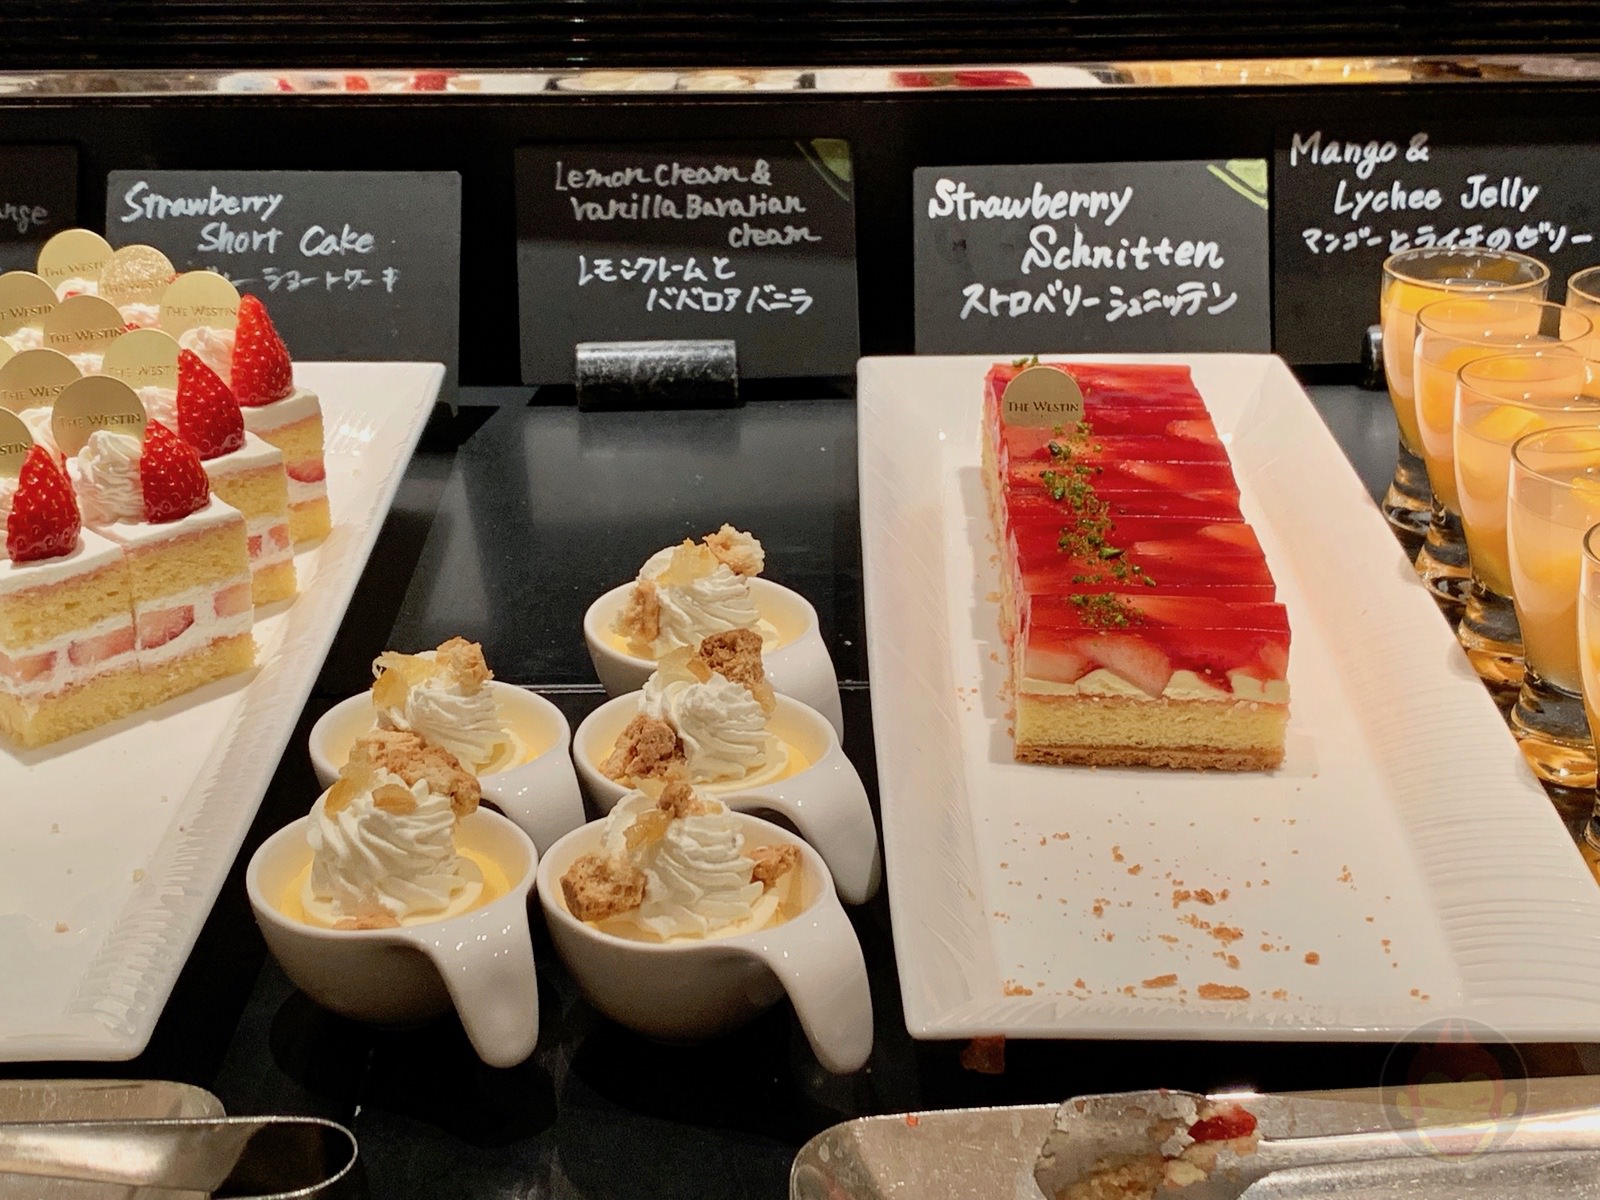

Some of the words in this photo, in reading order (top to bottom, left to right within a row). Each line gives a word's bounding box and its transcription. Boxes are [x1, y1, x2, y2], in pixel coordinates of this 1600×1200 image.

[555, 160, 652, 192] Lemon
[750, 158, 773, 186] &
[1290, 131, 1398, 180] Mango
[1405, 132, 1430, 163] &
[120, 180, 284, 223] Strawberry
[928, 178, 1134, 227] Strawberry
[1333, 179, 1442, 221] Lychee
[1460, 173, 1540, 213] Jelly
[197, 220, 283, 255] Short
[300, 223, 376, 257] Cake
[1021, 224, 1225, 275] Schnitten
[87, 413, 141, 426] WESTIN
[1008, 401, 1028, 412] THE
[1033, 400, 1079, 413] WESTIN
